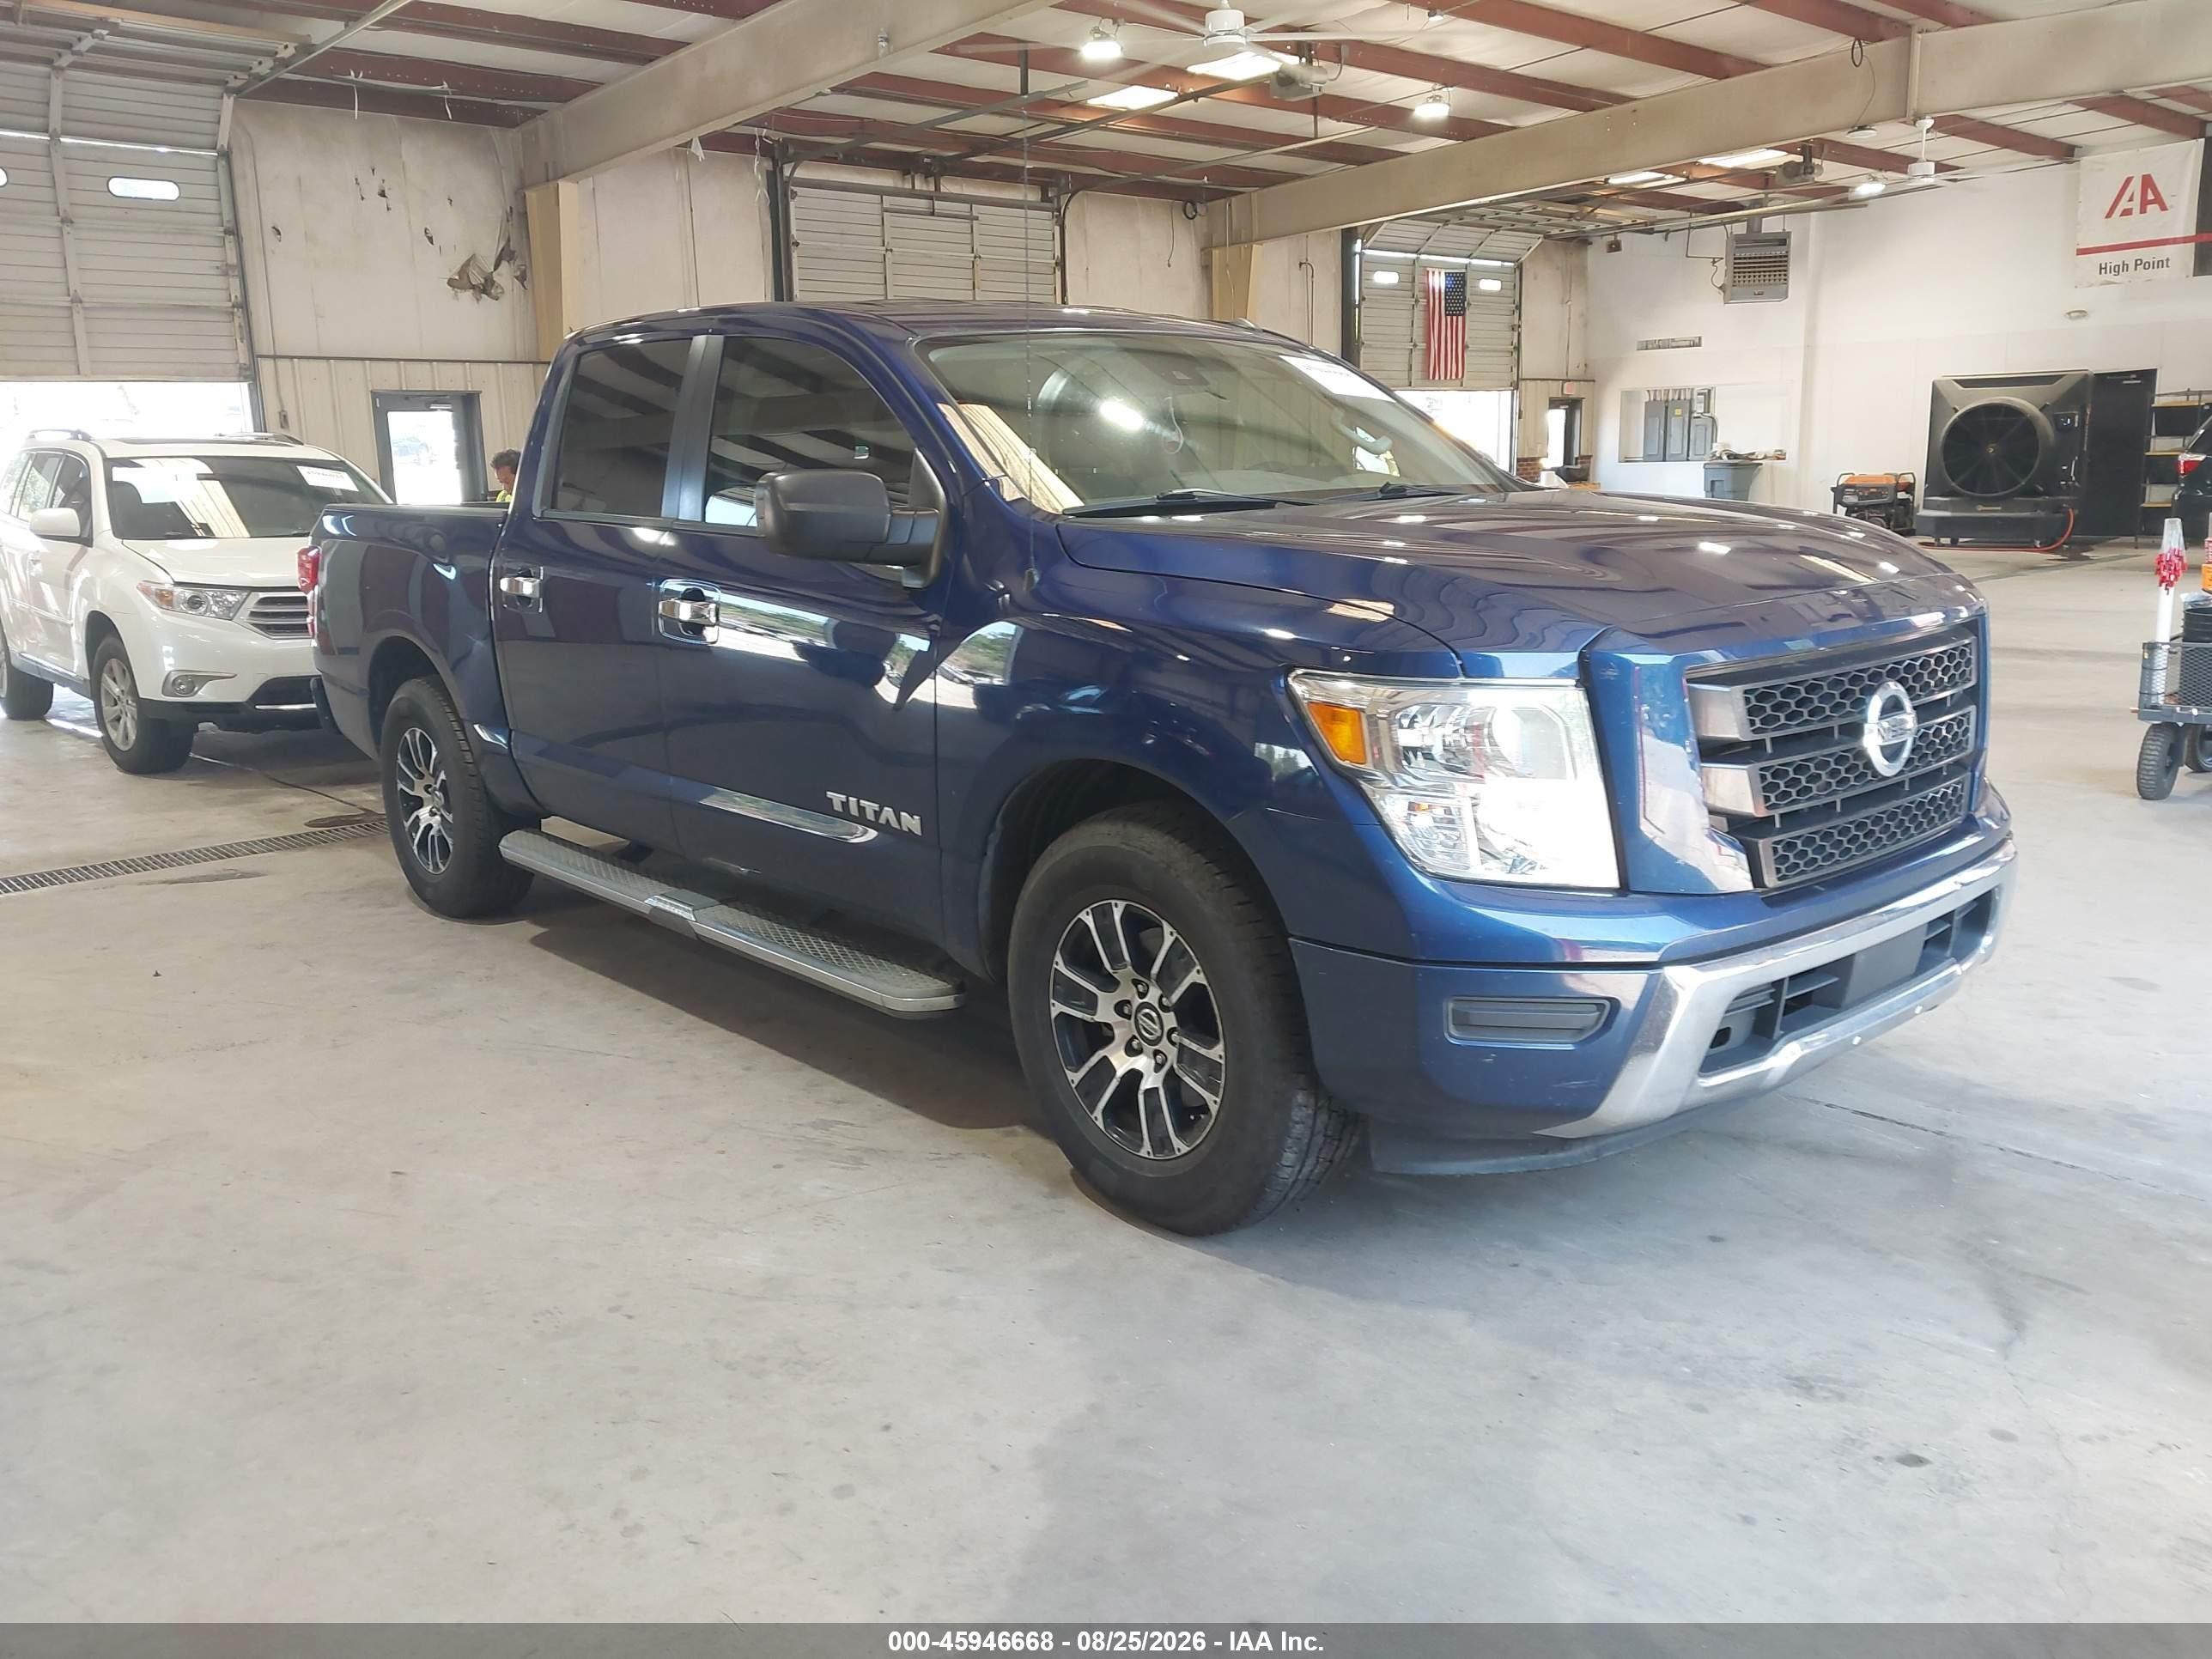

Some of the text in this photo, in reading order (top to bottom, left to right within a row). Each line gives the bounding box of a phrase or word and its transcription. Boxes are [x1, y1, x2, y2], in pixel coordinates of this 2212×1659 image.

[2099, 257, 2171, 276] High Point
[825, 791, 922, 836] TITAN
